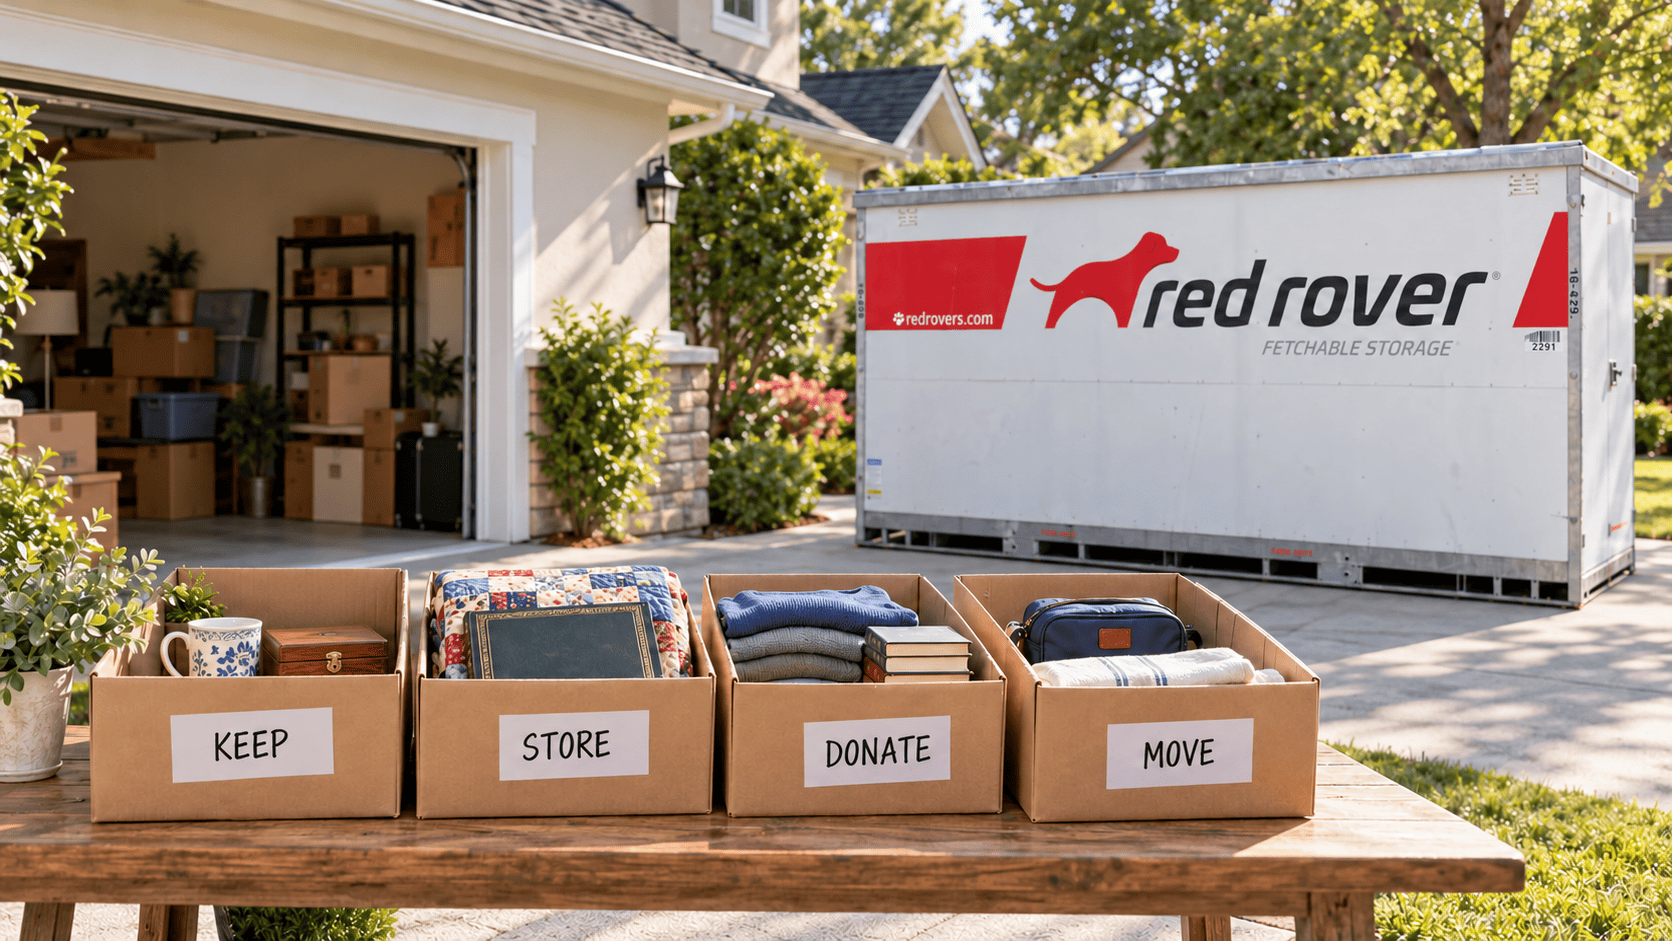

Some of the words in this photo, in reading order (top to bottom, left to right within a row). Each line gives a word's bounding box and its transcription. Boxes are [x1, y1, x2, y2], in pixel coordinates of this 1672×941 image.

[1143, 259, 1267, 328] red
[1267, 271, 1489, 327] rover
[906, 310, 993, 326] redrovers.com
[1262, 340, 1360, 356] FETCHABLE
[1365, 340, 1454, 356] STORAGE
[1532, 342, 1556, 351] 2291
[214, 728, 289, 762] KEEP
[522, 729, 611, 762] STORE
[825, 734, 931, 769] DONATE
[1143, 738, 1215, 770] MOVE
